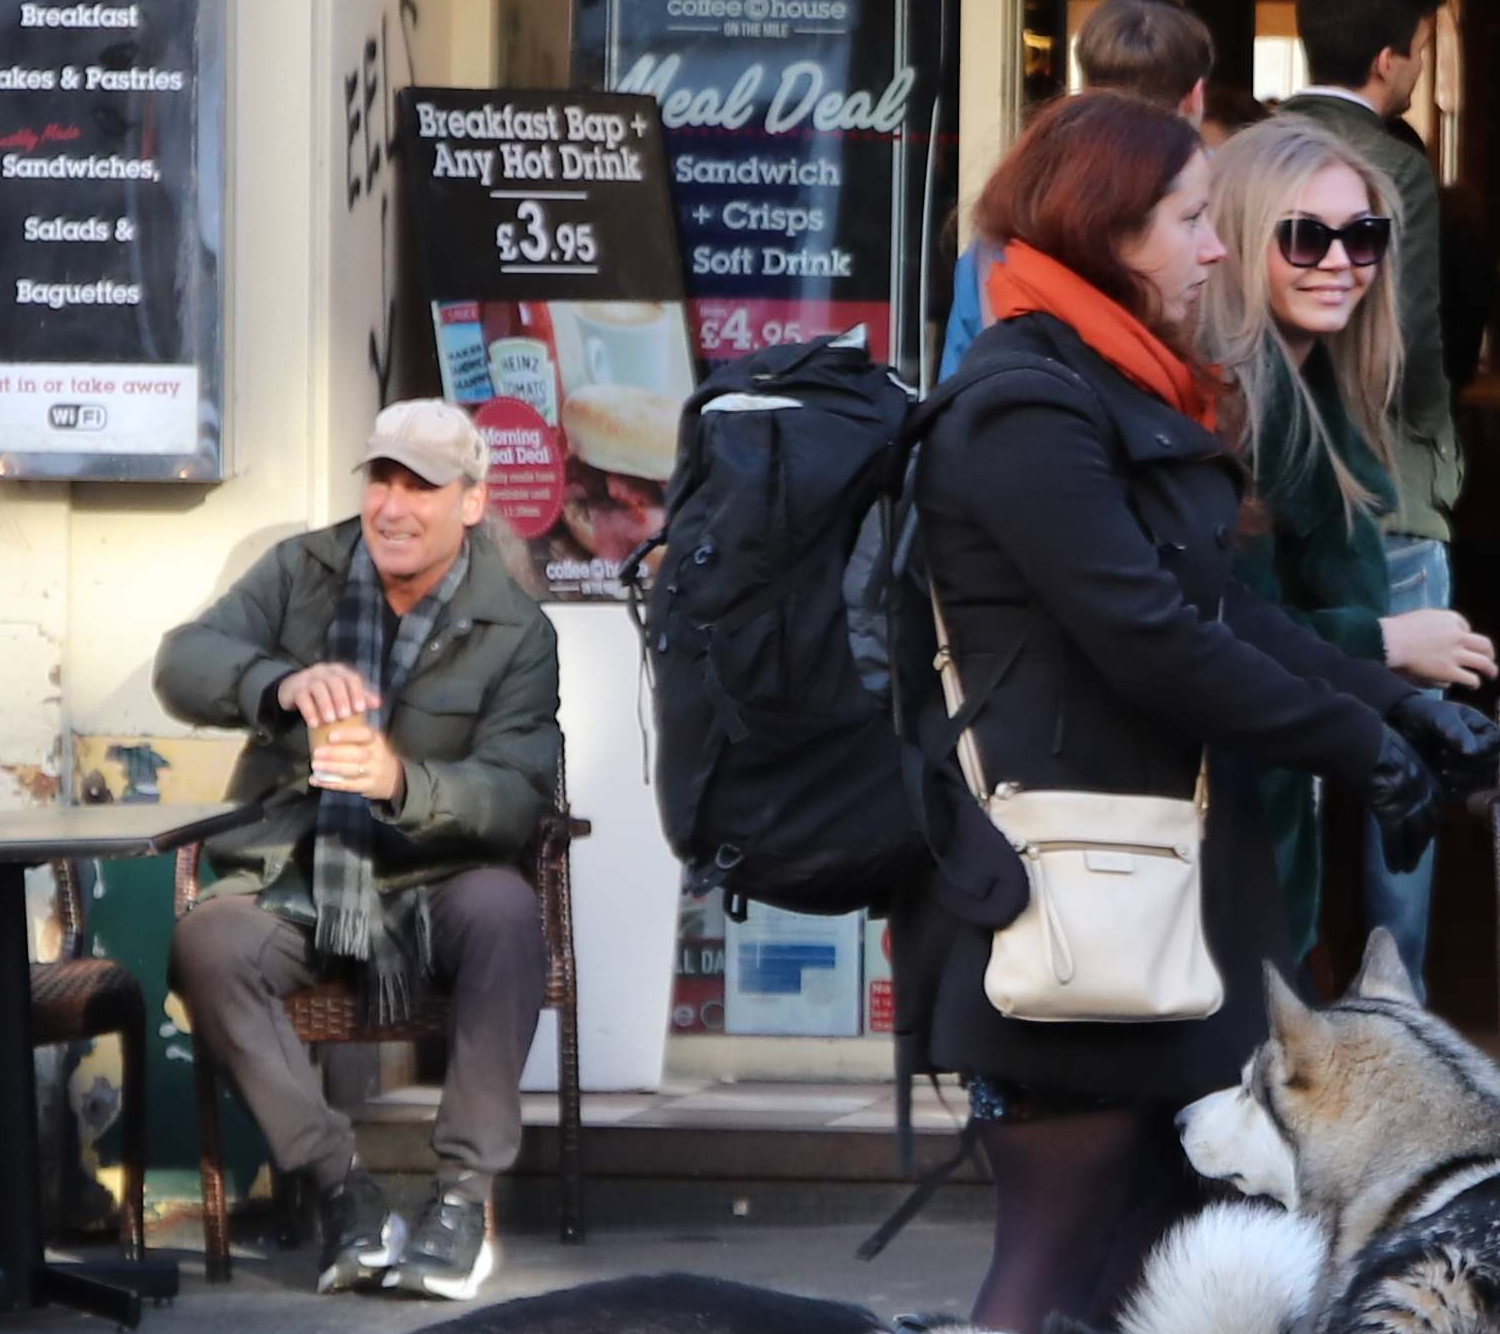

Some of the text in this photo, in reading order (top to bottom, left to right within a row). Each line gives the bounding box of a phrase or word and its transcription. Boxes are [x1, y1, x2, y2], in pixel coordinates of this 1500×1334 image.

[19, 3, 139, 28] Breakfast
[723, 22, 789, 39] ON THE MILE
[59, 66, 80, 90] &
[85, 65, 184, 92] Pastries
[617, 53, 915, 135] Meal Deal
[416, 102, 648, 149] Breakfast Bap +
[2, 154, 162, 181] Sandwiches,
[433, 143, 643, 185] Any Hot Drink
[676, 157, 841, 187] Sandwich
[24, 216, 135, 242] Salads &
[496, 199, 598, 264] £3.95
[692, 200, 824, 235] + Crisps
[693, 246, 851, 276] Soft Drink
[16, 280, 142, 308] Baguettes
[701, 306, 802, 351] £4.95
[18, 375, 37, 394] in
[43, 379, 63, 395] or
[71, 375, 115, 395] take
[122, 381, 181, 399] away
[489, 447, 549, 464] eal Deal
